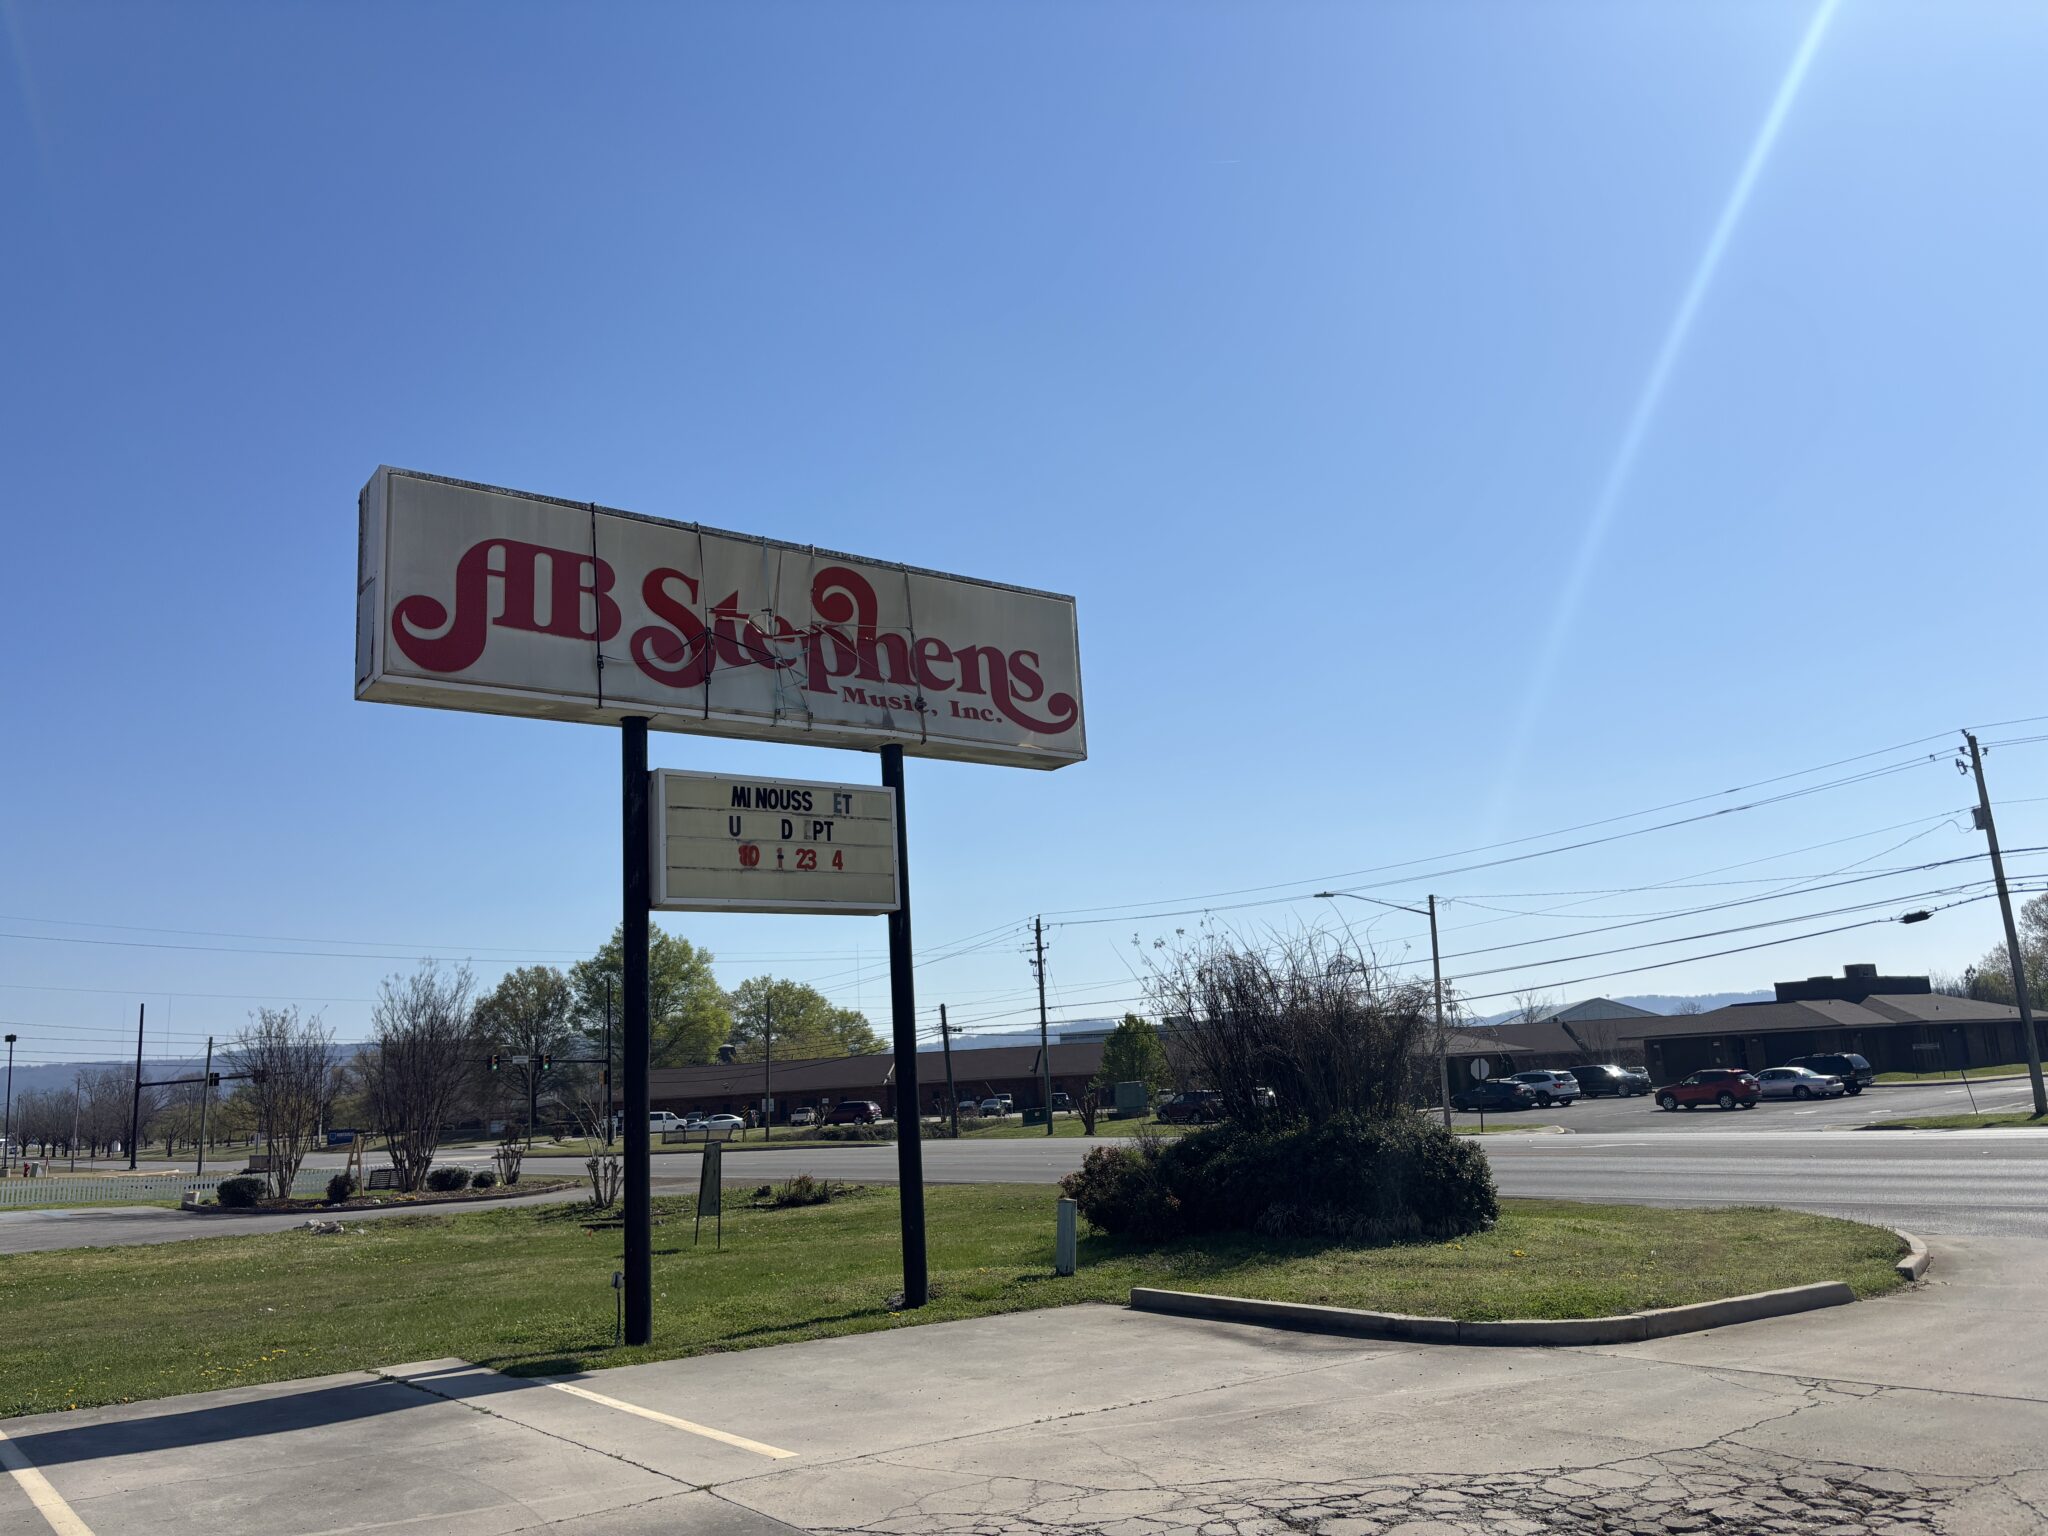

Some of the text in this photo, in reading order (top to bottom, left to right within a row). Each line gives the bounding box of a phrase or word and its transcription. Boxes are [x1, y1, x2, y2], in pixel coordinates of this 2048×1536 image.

[630, 566, 1078, 735] Stephens
[949, 700, 1003, 723] Inc.
[729, 816, 741, 837] U
[796, 848, 817, 871] 23
[832, 850, 843, 870] 4
